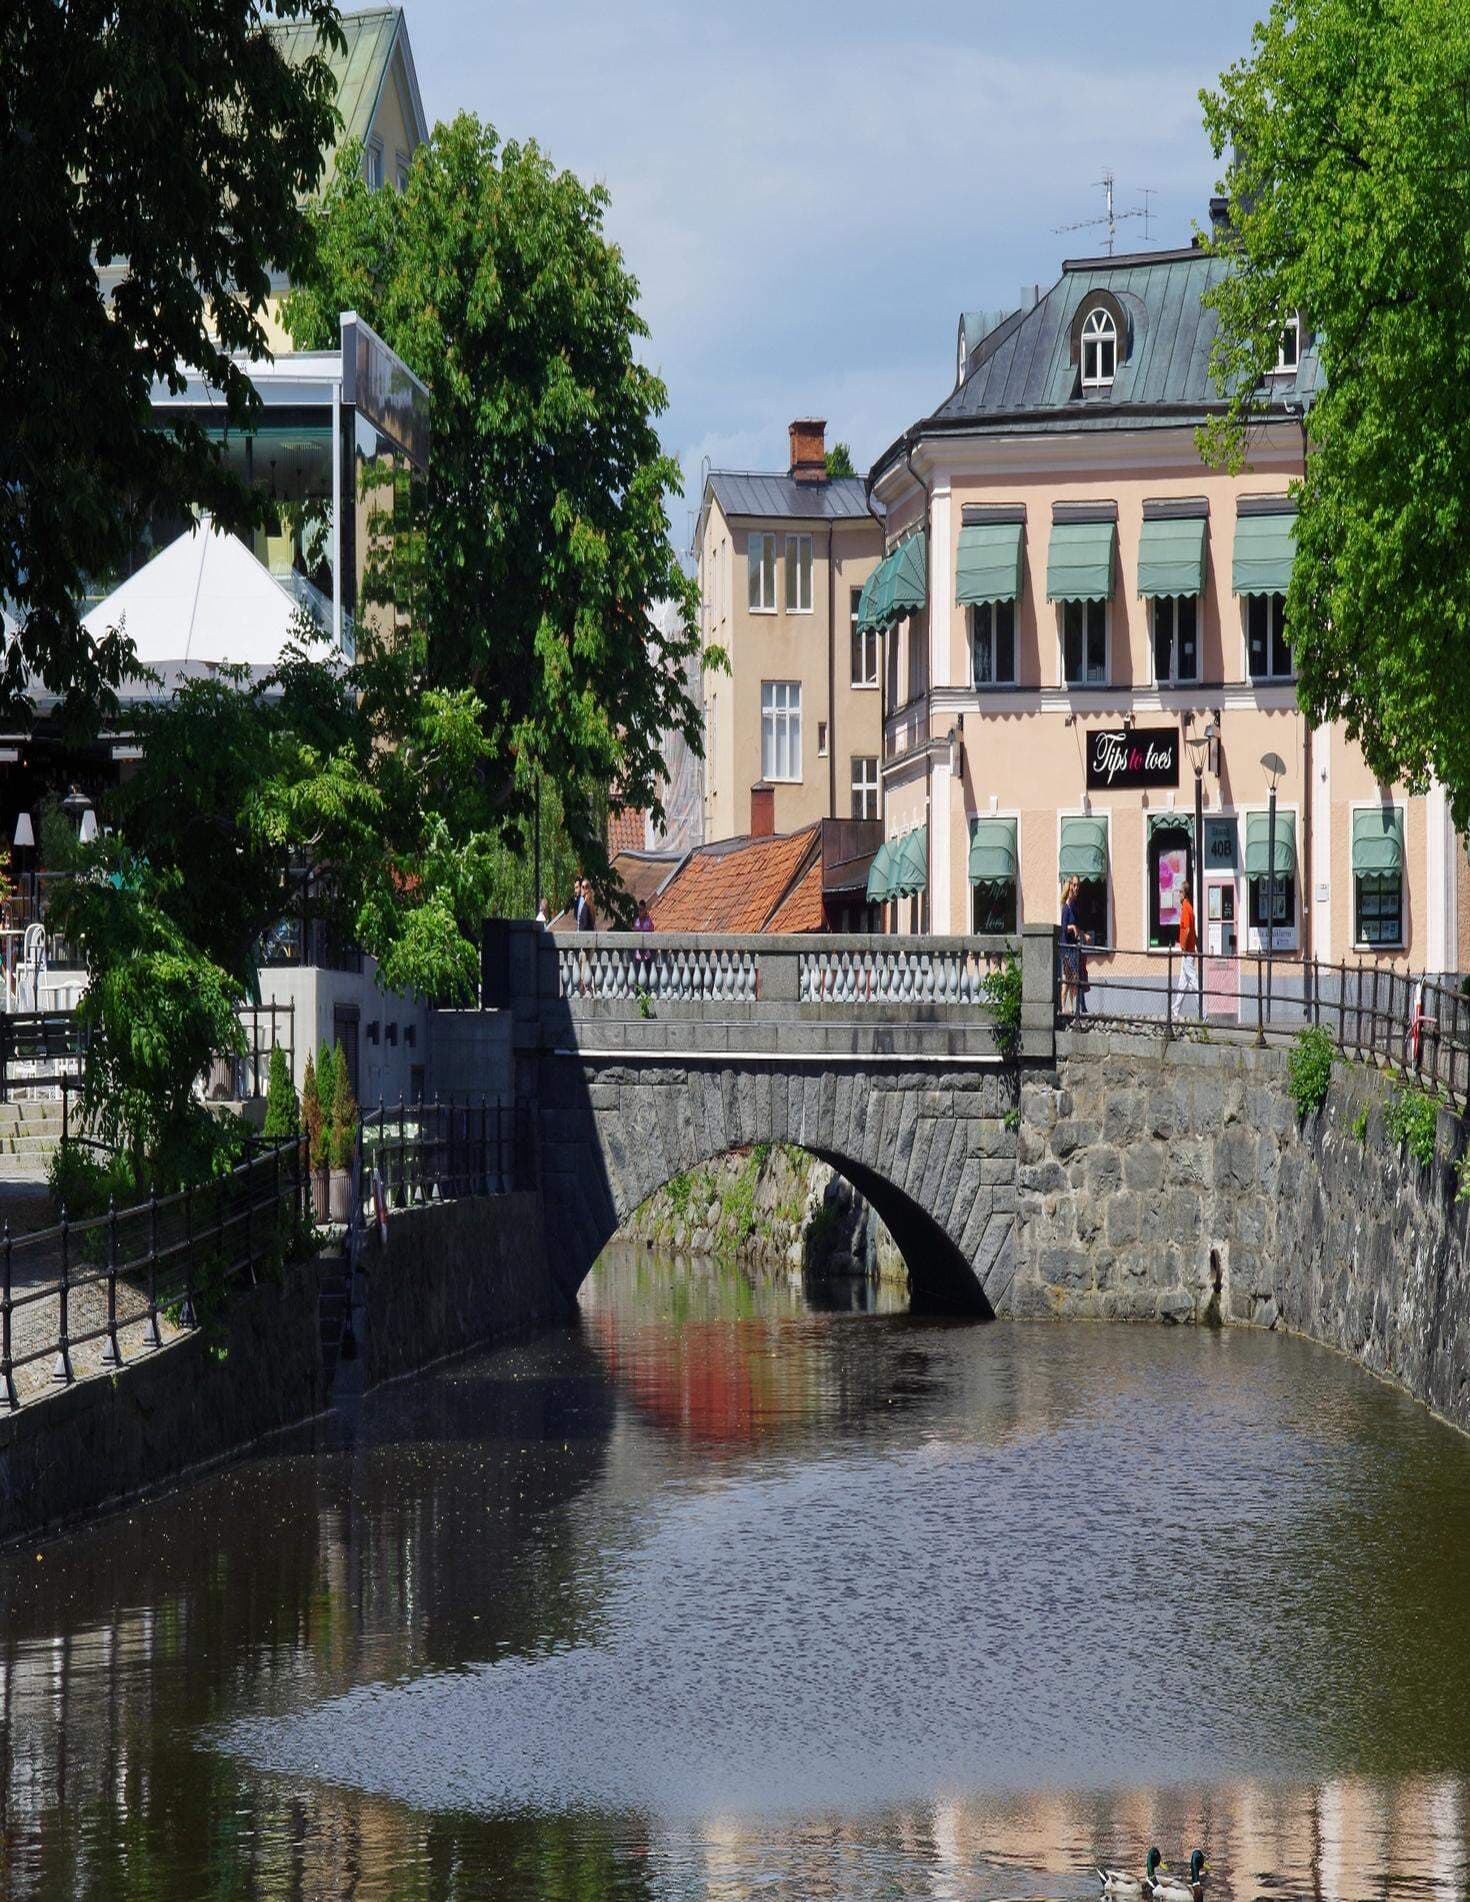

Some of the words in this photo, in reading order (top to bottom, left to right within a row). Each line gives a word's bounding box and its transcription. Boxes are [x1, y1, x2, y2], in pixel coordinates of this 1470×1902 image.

[1093, 732, 1128, 784] Tips
[1129, 748, 1142, 770] to
[1145, 742, 1172, 770] toes
[1211, 840, 1232, 857] 40B
